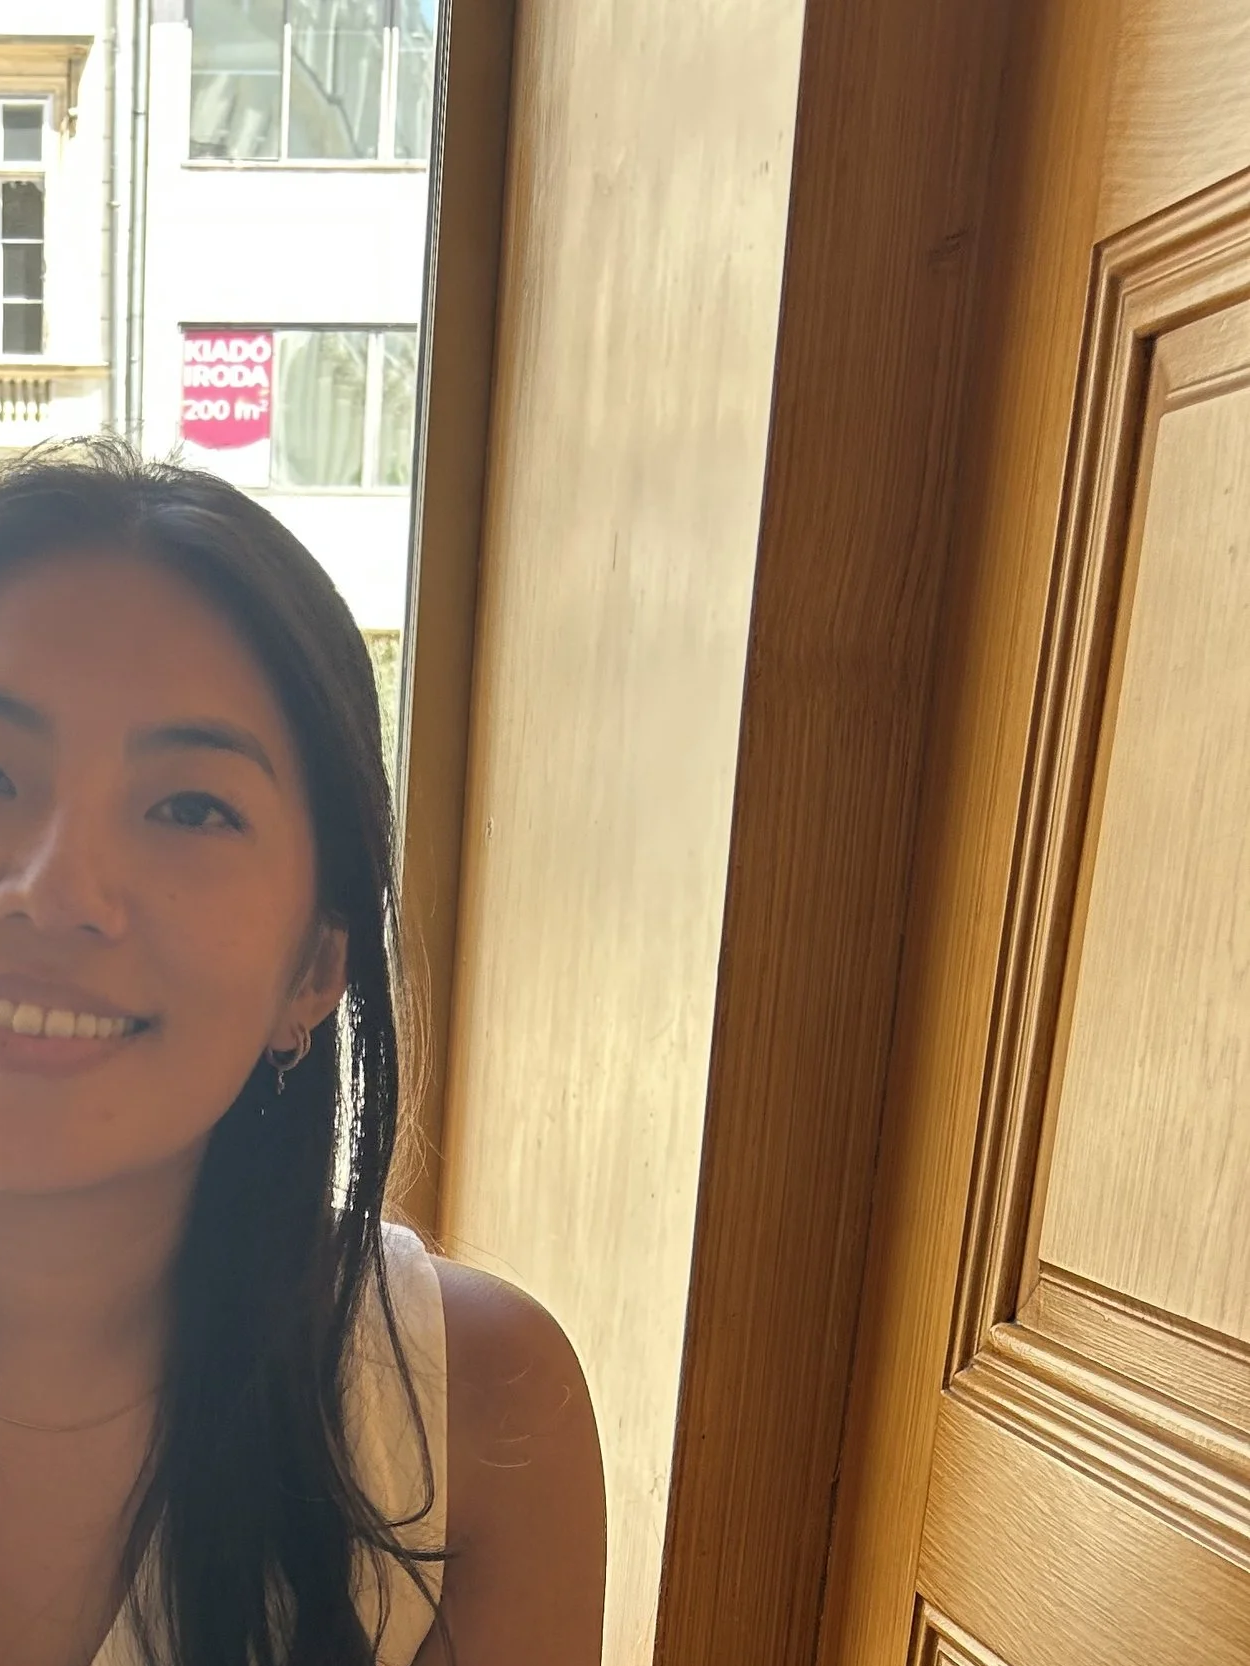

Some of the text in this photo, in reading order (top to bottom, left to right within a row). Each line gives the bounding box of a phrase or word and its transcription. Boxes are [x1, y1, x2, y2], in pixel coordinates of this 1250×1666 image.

[185, 337, 271, 363] KIADÓ
[184, 365, 269, 388] IRODA
[184, 399, 229, 421] 200
